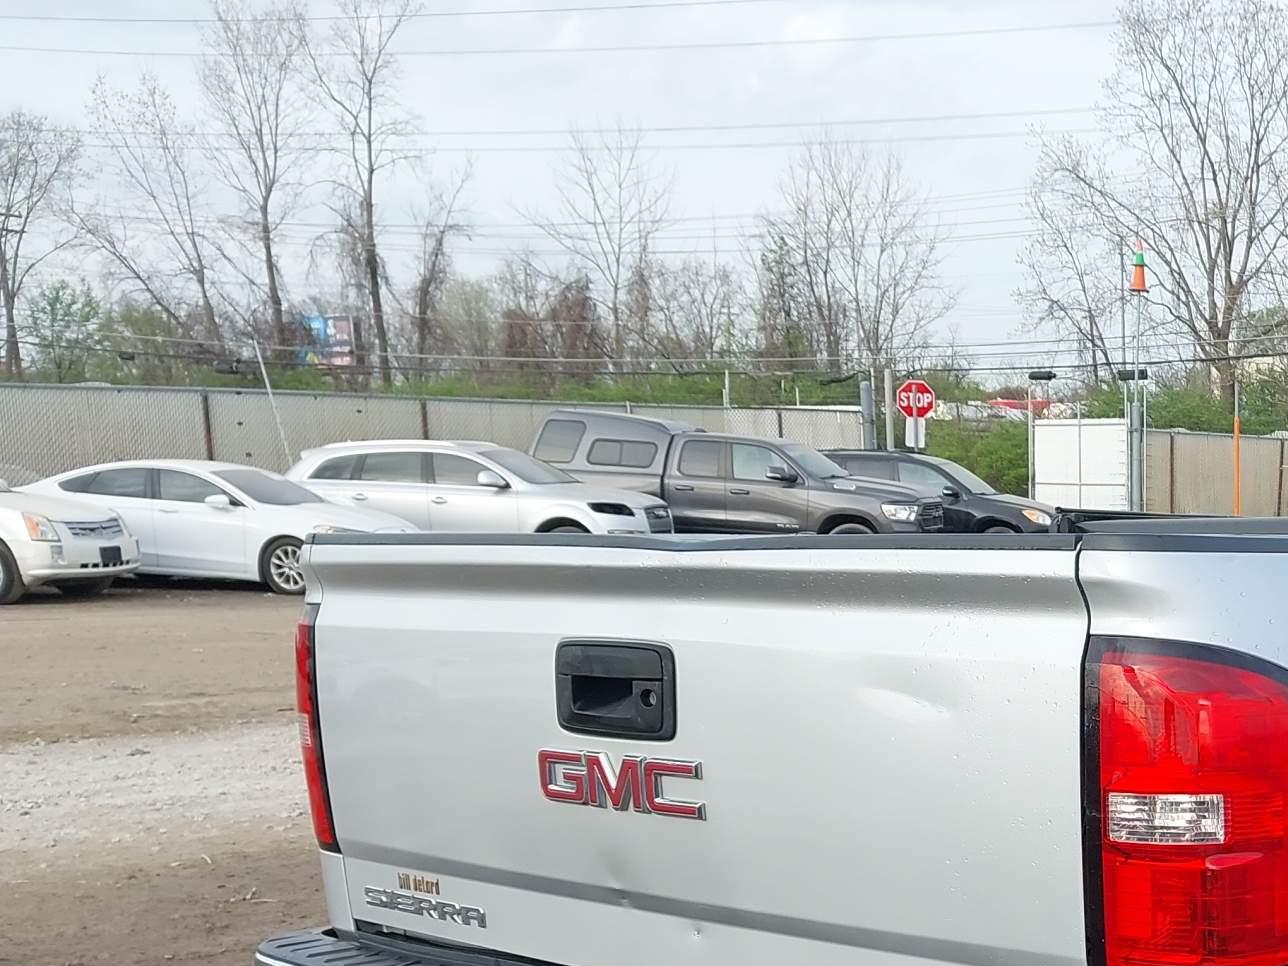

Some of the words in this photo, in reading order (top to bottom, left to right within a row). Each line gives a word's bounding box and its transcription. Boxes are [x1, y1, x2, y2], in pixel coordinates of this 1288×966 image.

[900, 391, 932, 408] STOP
[537, 748, 707, 821] GMC
[364, 885, 487, 929] SIERRA
